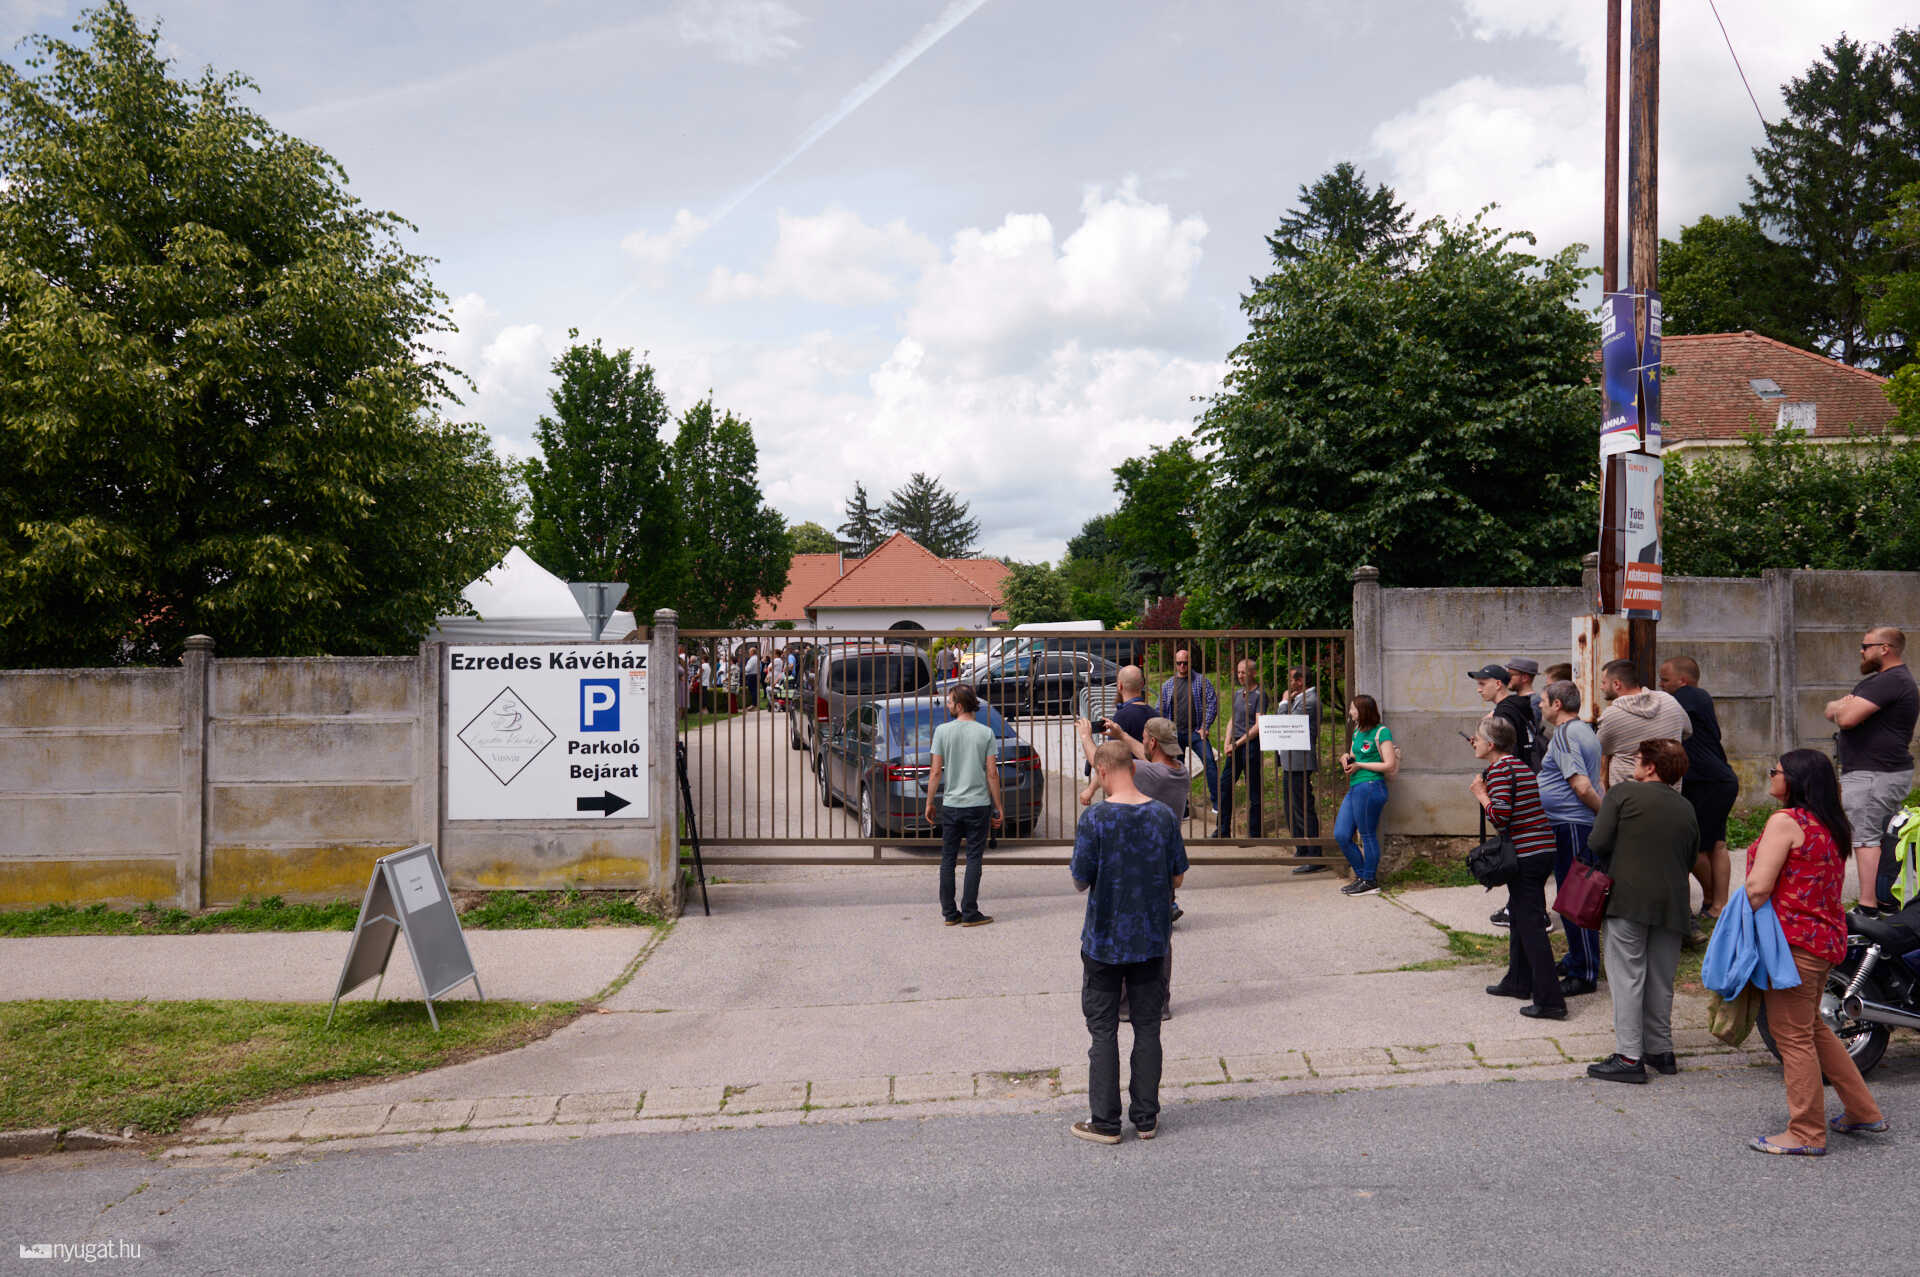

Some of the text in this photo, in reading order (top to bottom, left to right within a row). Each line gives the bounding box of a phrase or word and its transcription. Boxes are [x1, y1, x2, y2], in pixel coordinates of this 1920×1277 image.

[450, 650, 647, 670] Ezredes Kávéház
[584, 685, 616, 726] P
[568, 738, 640, 755] Parkoló
[570, 763, 639, 782] Bejárat
